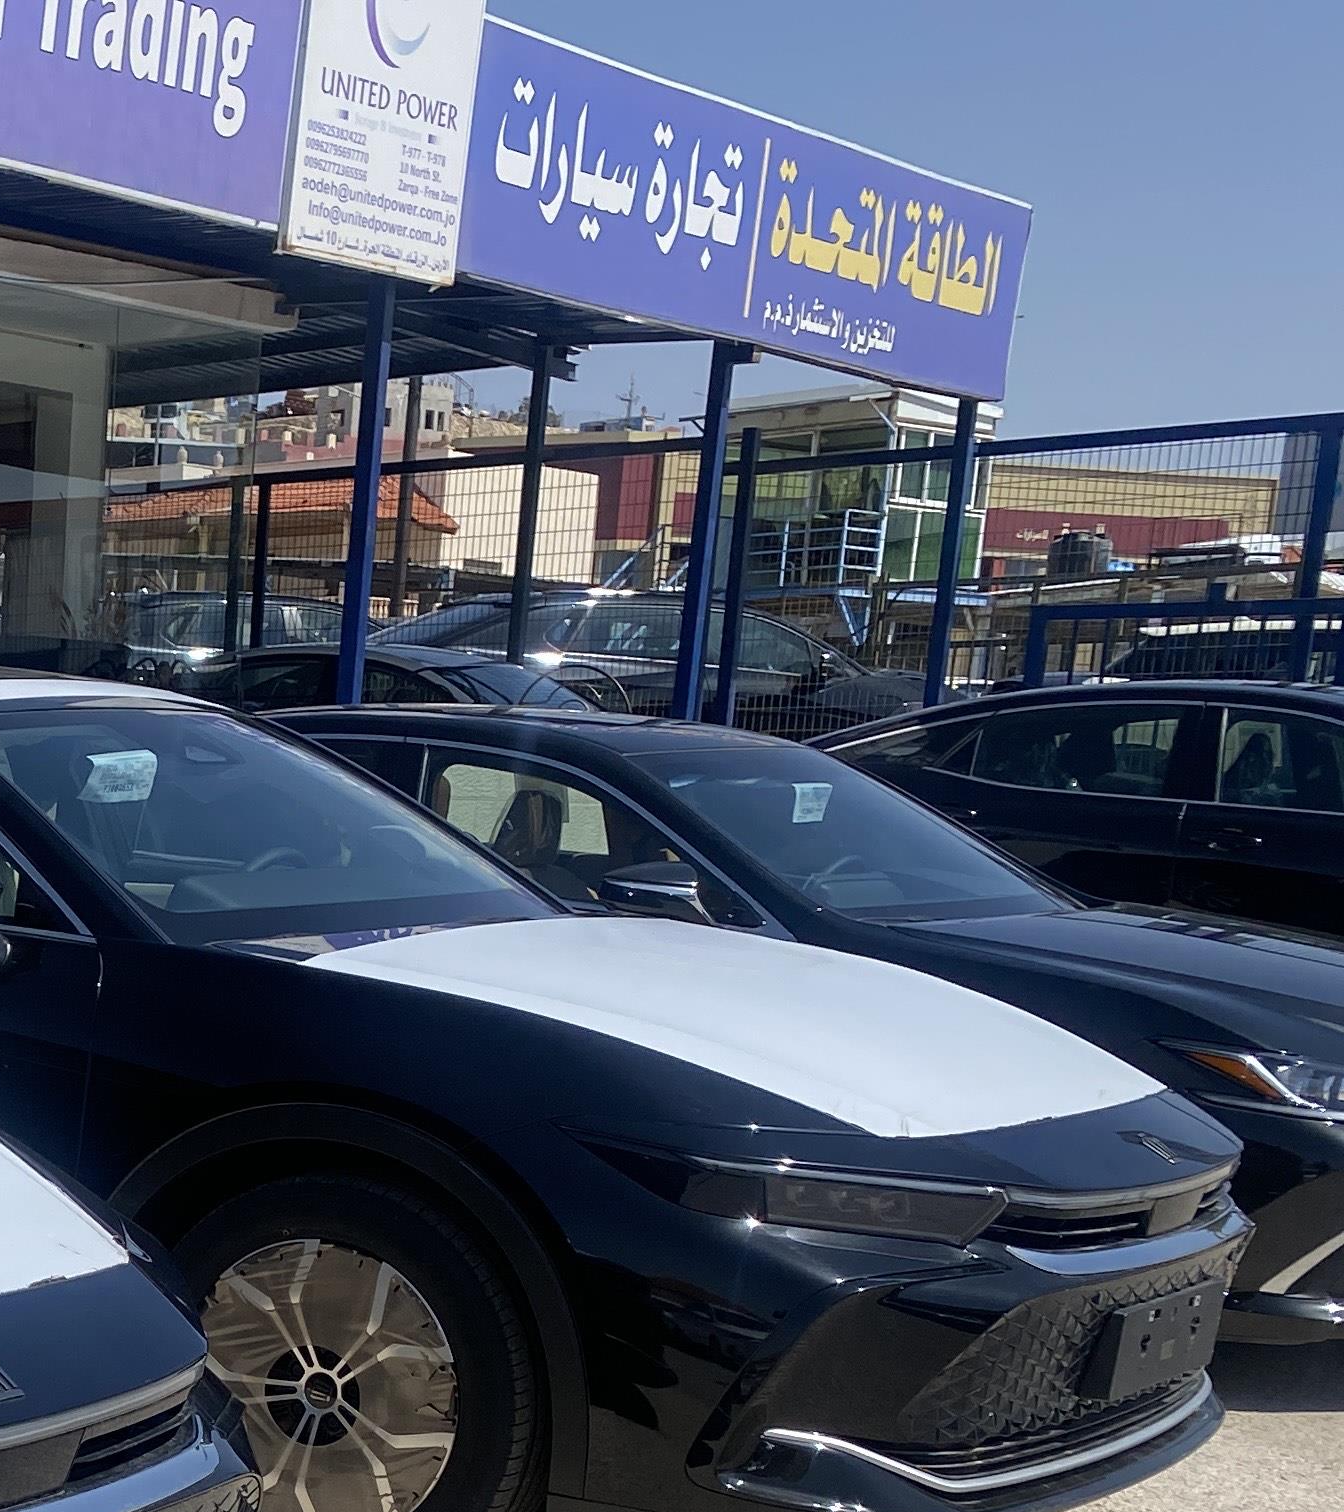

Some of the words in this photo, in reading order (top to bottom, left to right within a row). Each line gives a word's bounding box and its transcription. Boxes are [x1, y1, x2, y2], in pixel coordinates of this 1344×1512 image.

[321, 66, 391, 110] UNITED
[396, 89, 458, 131] POWER
[302, 176, 456, 228] aodeh@unitedpower.com.jo
[495, 76, 639, 243] سيارات
[646, 120, 743, 271] تجارة
[771, 157, 897, 294] المتحدة
[898, 200, 1003, 316] الطاقة
[850, 317, 895, 355] للتخزين
